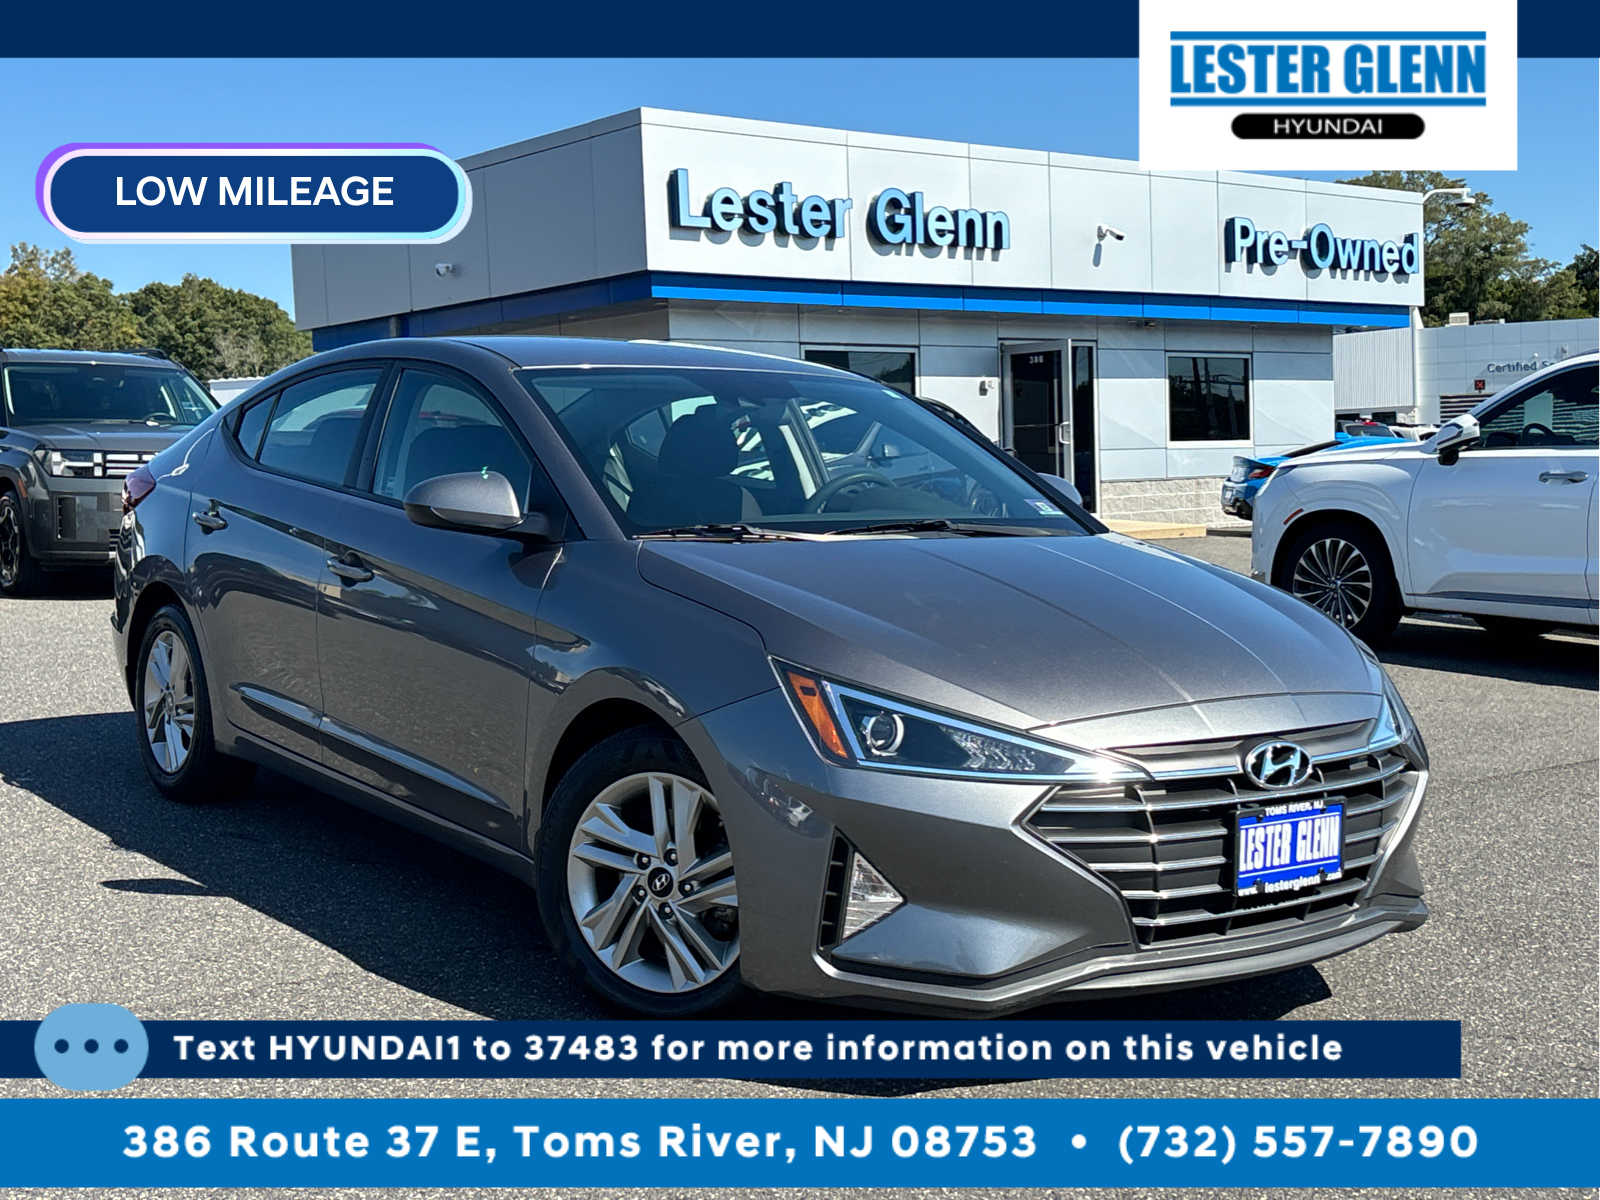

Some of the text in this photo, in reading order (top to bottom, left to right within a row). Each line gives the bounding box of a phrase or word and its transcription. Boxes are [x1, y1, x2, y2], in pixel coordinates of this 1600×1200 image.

[667, 168, 1010, 250] Lester Glenn
[1225, 217, 1420, 274] Pre-Owned
[1487, 362, 1537, 373] Certified
[1265, 805, 1287, 816] TOMS
[1239, 815, 1340, 872] LESTER GLENN
